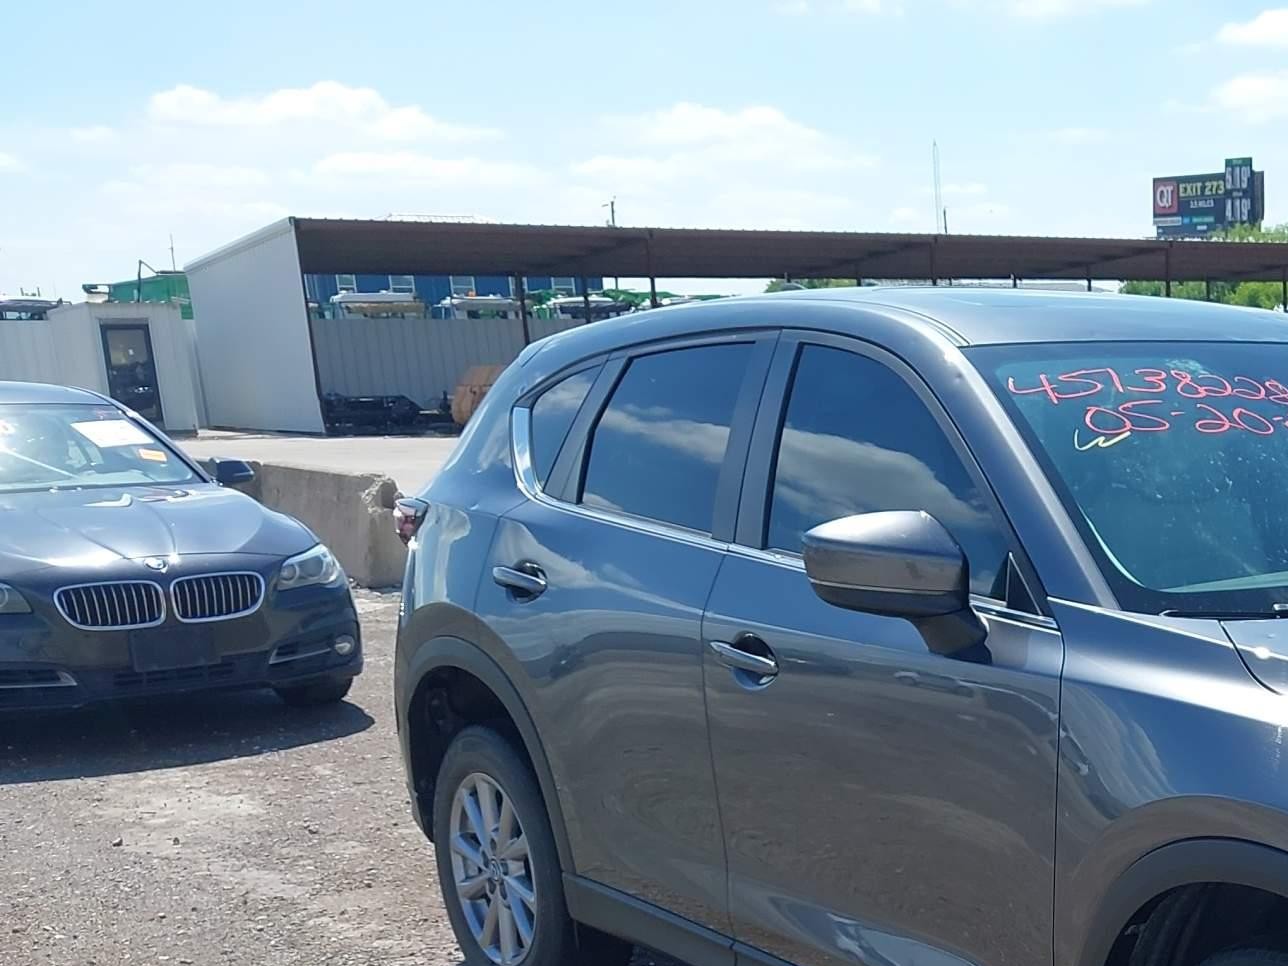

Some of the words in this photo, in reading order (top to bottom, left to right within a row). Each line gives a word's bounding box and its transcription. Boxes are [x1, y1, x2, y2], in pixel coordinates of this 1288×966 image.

[1156, 185, 1174, 208] QT
[1179, 182, 1203, 197] EXIT
[1204, 180, 1225, 195] 273
